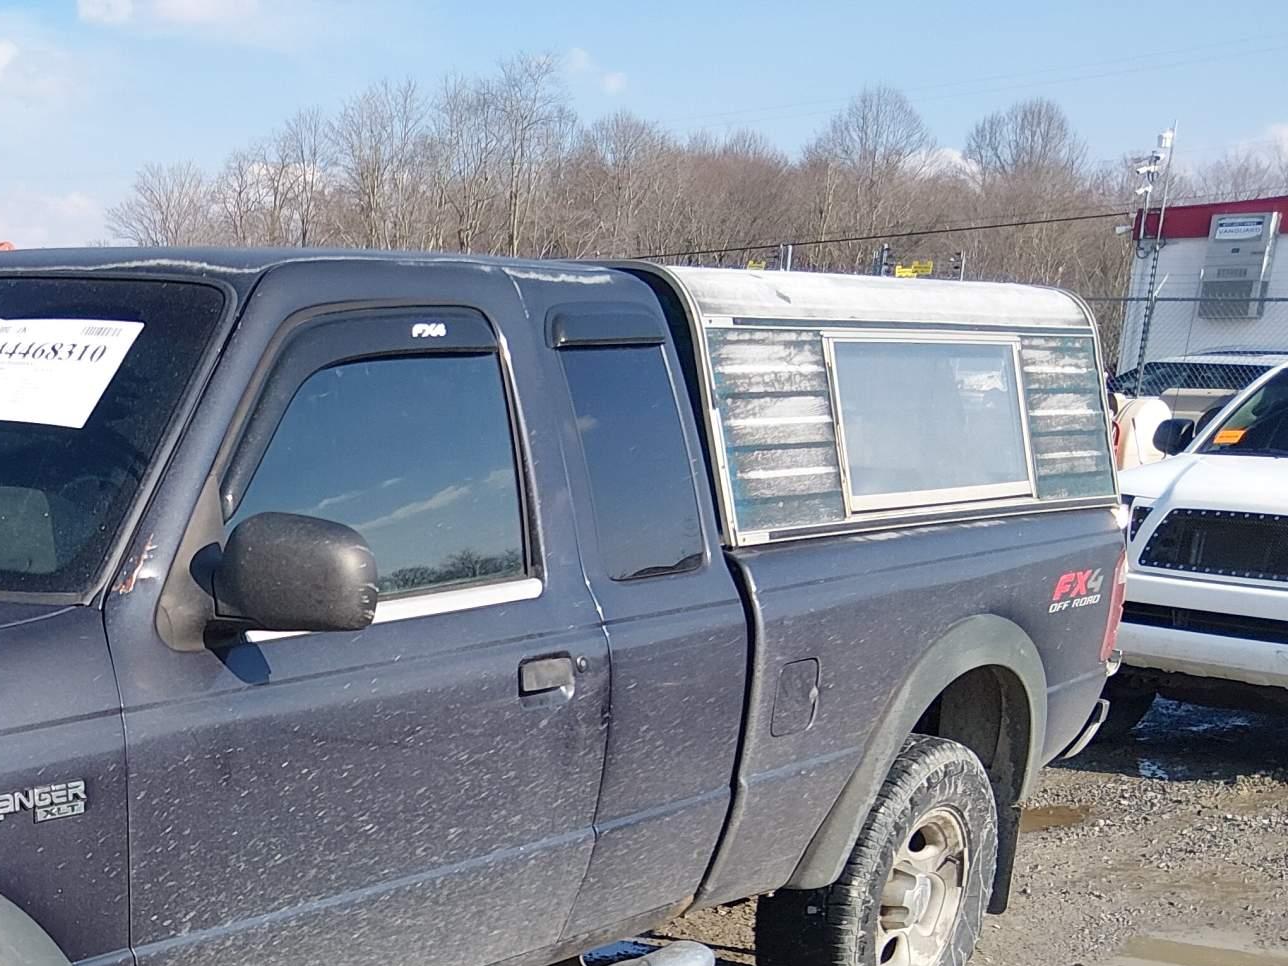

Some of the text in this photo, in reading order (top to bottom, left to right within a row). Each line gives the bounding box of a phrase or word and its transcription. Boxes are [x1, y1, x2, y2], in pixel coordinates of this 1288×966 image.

[1053, 567, 1104, 601] FX4
[1048, 594, 1102, 613] OFF ROAD
[43, 803, 81, 818] XLT
